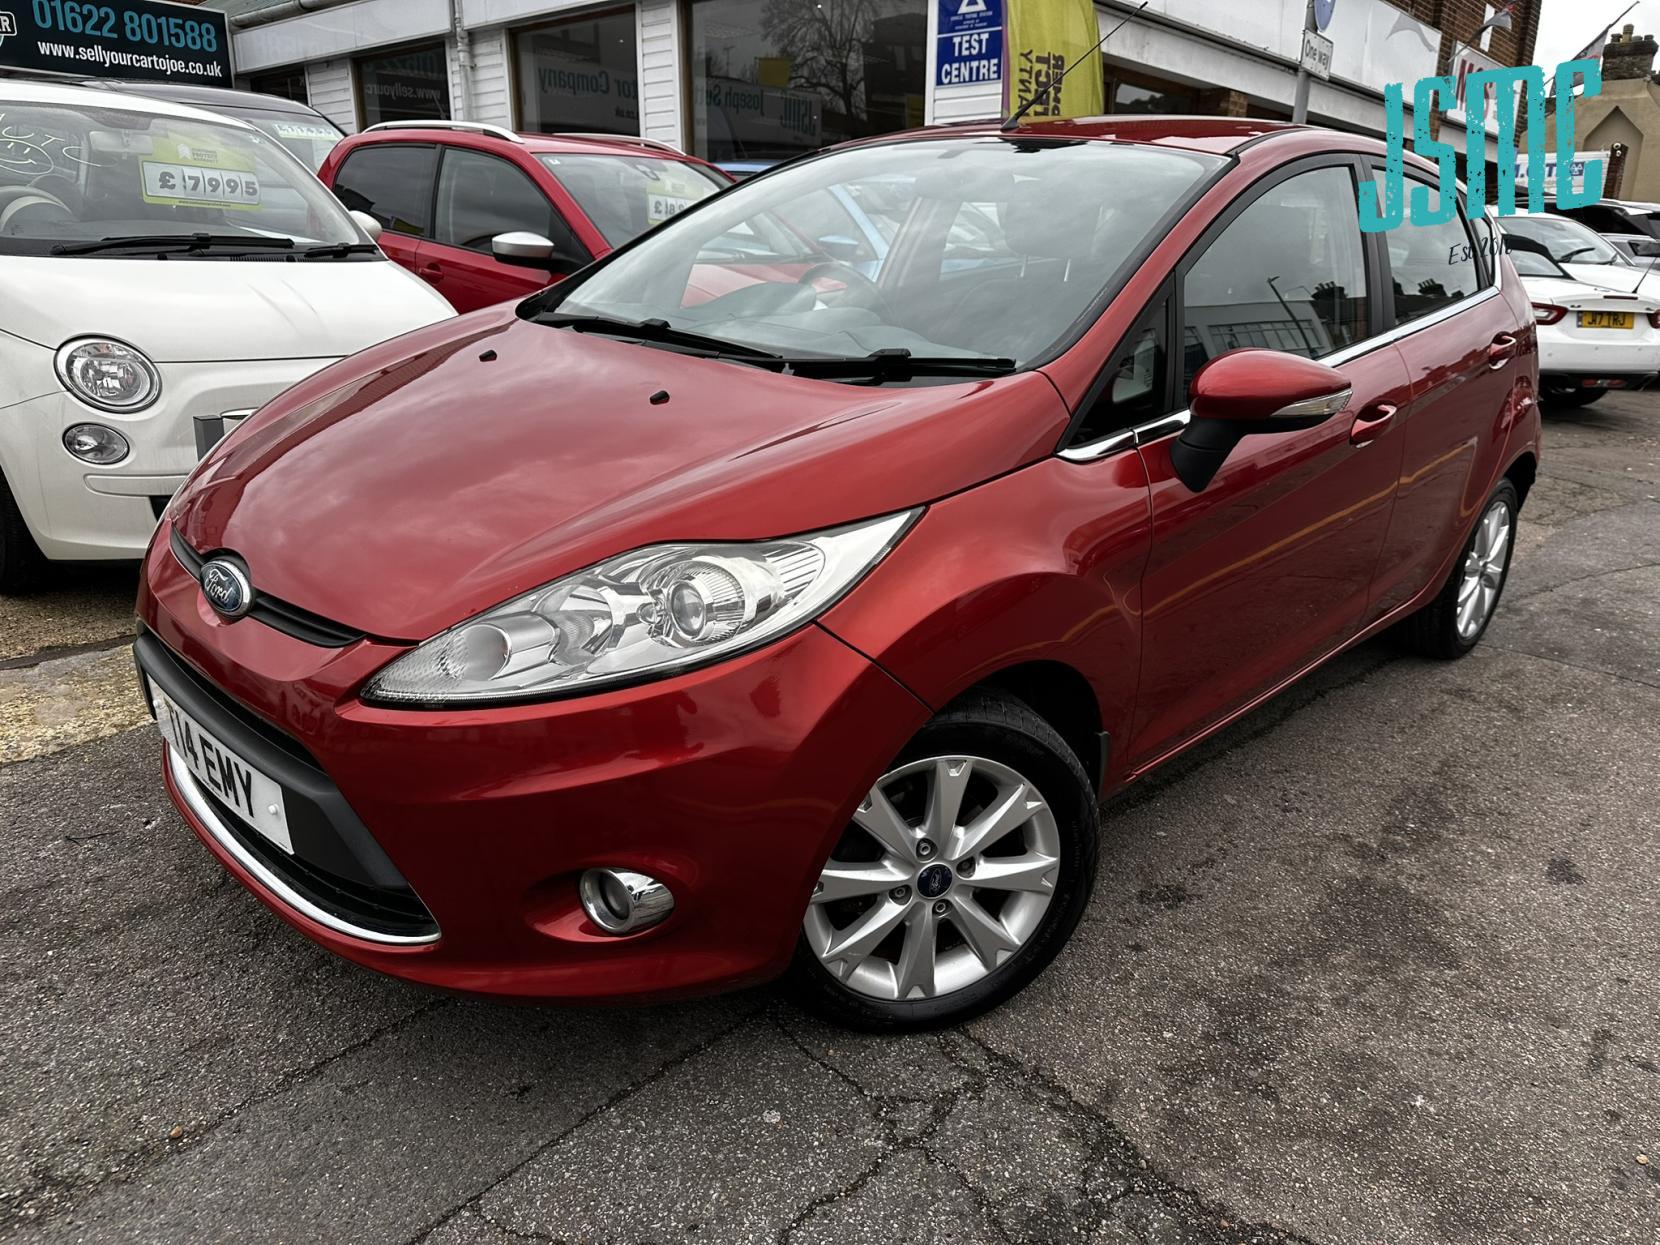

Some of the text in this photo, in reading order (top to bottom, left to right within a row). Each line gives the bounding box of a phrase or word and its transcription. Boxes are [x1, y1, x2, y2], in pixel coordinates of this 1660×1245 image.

[32, 0, 218, 52] 01622 801588
[37, 40, 223, 78] www.sellyourcartojoe.co.uk
[952, 32, 990, 57] TEST
[1304, 39, 1330, 70] One way
[941, 58, 999, 84] CENTRE
[204, 568, 232, 603] Ford
[198, 733, 254, 819] EMY
